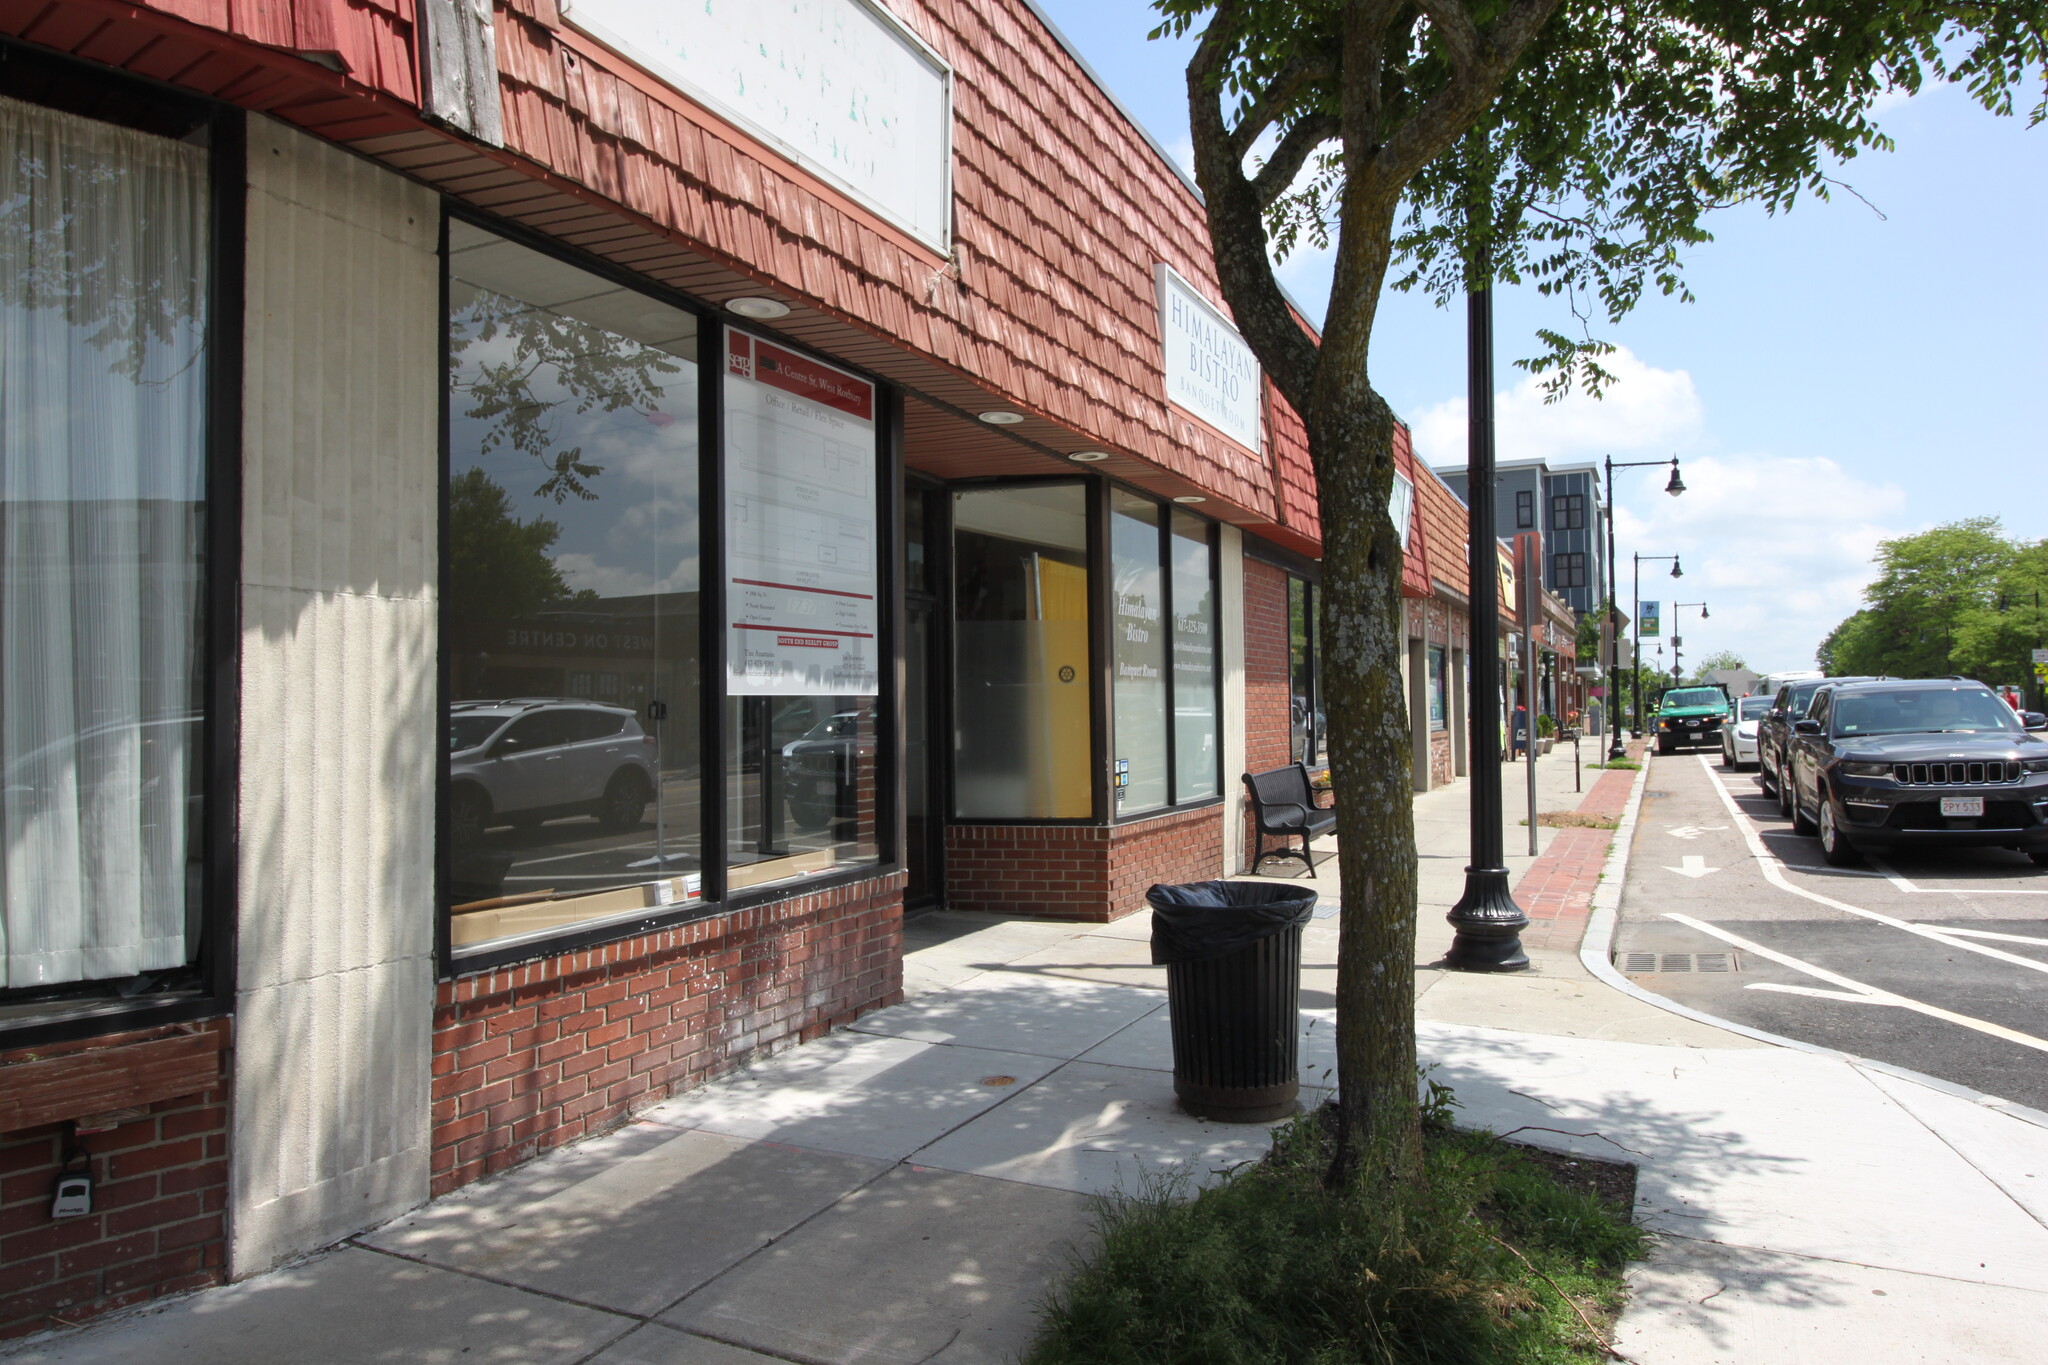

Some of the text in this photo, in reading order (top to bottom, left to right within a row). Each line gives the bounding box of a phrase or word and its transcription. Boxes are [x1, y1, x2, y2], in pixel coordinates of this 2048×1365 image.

[1172, 293, 1253, 384] HIMALAYAN
[728, 352, 751, 379] serg
[1189, 341, 1239, 403] BISTRO
[784, 366, 807, 384] Centre
[808, 374, 819, 388] St.
[819, 377, 837, 395] West
[836, 384, 862, 406] Roxbury
[765, 393, 786, 411] Office
[791, 401, 810, 418] Retail
[814, 410, 828, 425] Flex
[827, 415, 845, 430] Space
[1180, 375, 1246, 432] BANQUET ROOM
[1118, 596, 1157, 624] Himalayan
[777, 637, 794, 645] SOUTH
[804, 639, 822, 647] REALTY
[1126, 622, 1149, 643] Bistro
[1119, 661, 1158, 681] Banquet Room
[1943, 802, 1981, 812] 2PY 533
